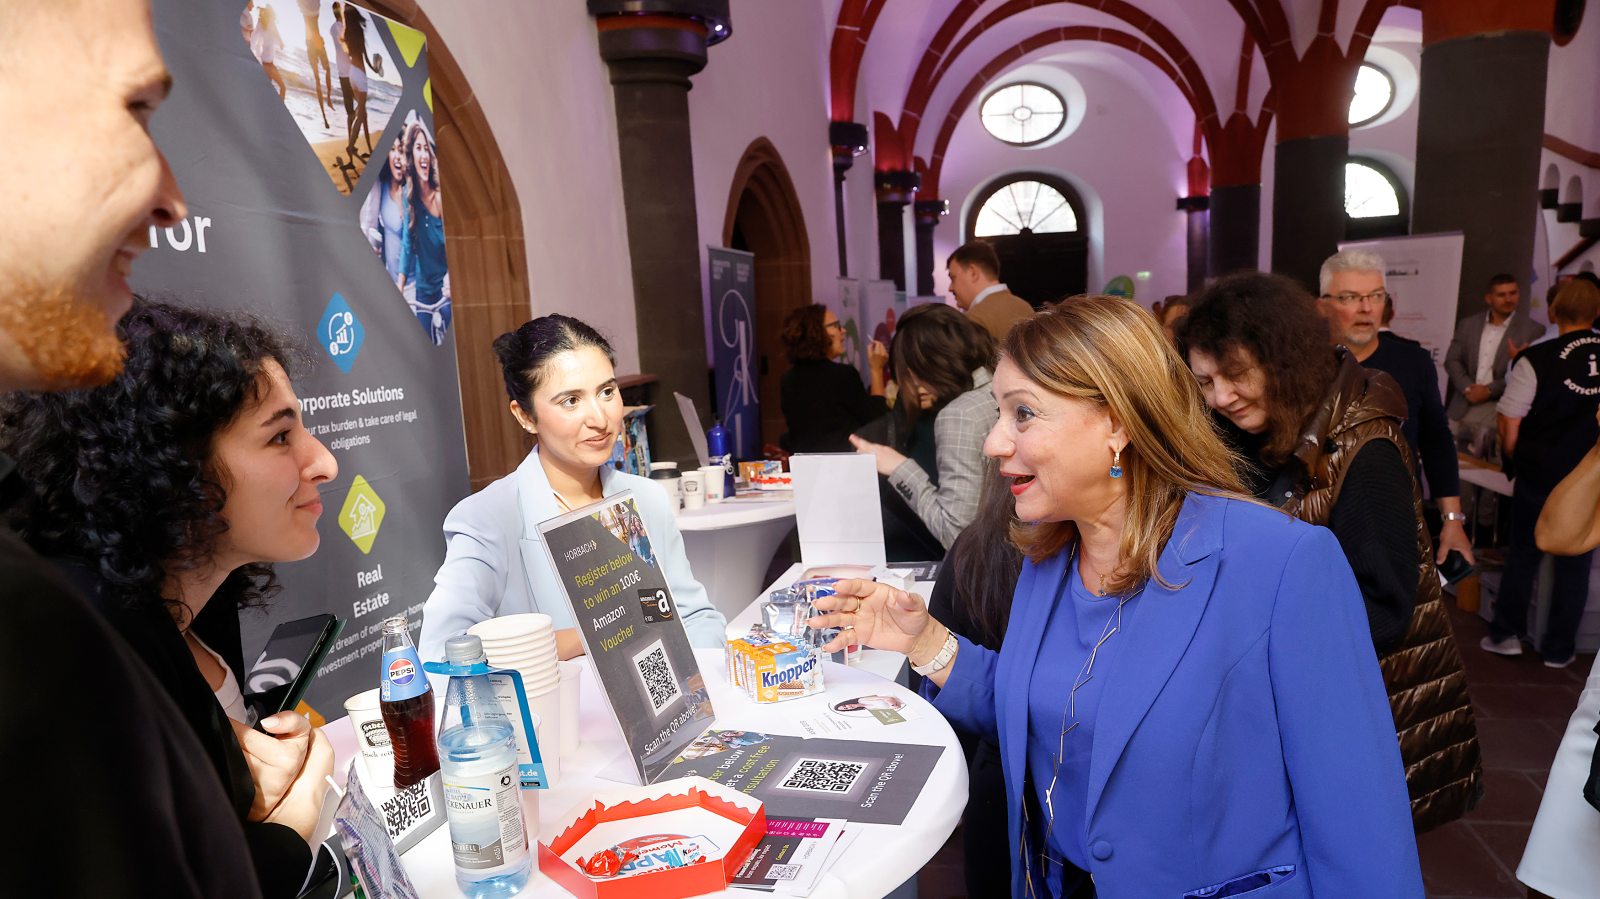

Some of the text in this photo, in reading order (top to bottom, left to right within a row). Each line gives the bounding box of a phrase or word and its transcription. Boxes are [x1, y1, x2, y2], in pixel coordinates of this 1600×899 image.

[297, 386, 404, 415] orporate Solutions
[317, 423, 330, 434] tax
[331, 419, 358, 433] burden
[358, 417, 364, 428] &
[364, 416, 379, 427] take
[380, 413, 394, 424] care
[395, 410, 402, 422] of
[402, 409, 418, 423] legal
[330, 434, 371, 450] obligations
[563, 540, 594, 562] HORBACH
[357, 564, 383, 588] Real
[574, 552, 633, 588] Register below
[583, 569, 642, 610] to win an 100€
[353, 592, 390, 618] Estate
[592, 605, 626, 631] Amazon
[336, 632, 360, 651] dream
[360, 625, 368, 639] of
[600, 624, 635, 652] Voucher
[317, 649, 360, 678] investment
[360, 636, 386, 659] proper
[761, 654, 818, 688] Knoppers
[390, 667, 414, 678] PEPSI
[644, 703, 698, 755] Scan the QR above!
[717, 749, 745, 769] below
[739, 759, 759, 773] cost
[750, 745, 771, 759] free
[742, 759, 780, 795] nsultation
[861, 753, 905, 808] Scan the QR above!
